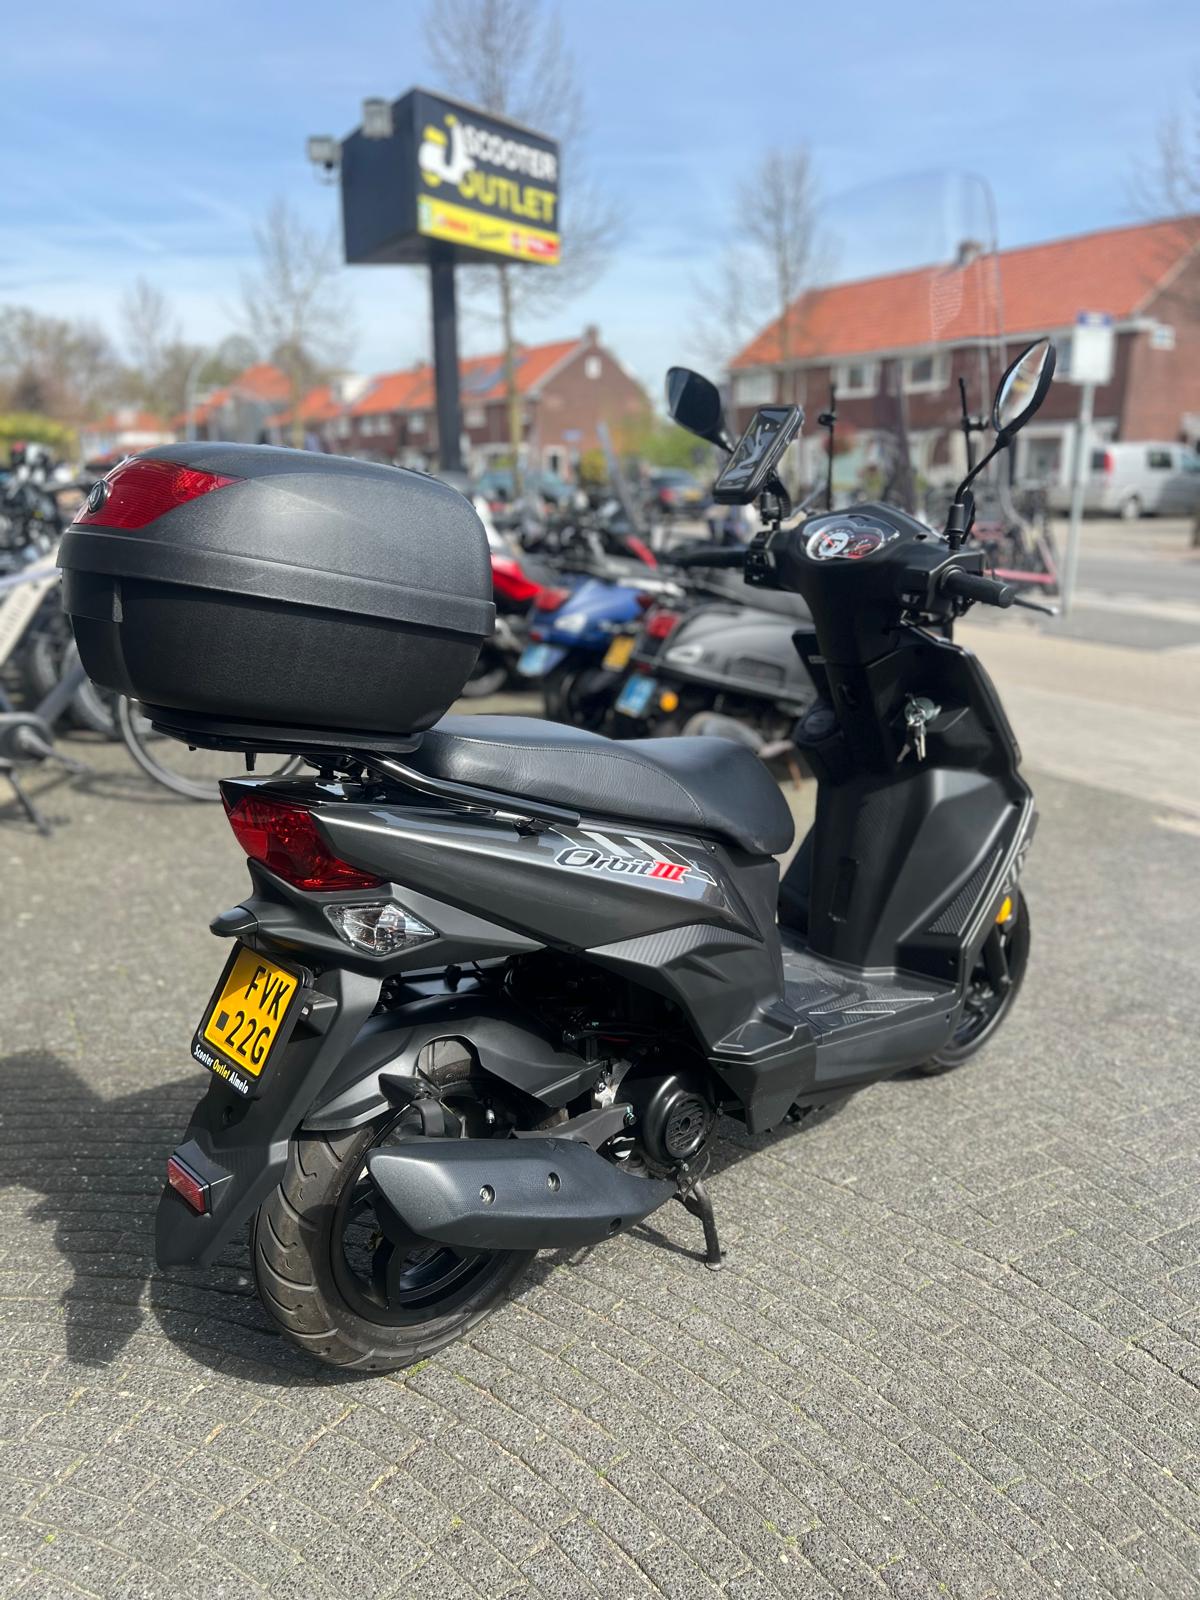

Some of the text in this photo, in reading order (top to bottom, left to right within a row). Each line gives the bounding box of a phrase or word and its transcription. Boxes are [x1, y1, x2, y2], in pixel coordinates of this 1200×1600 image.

[463, 125, 558, 183] SCOOTER
[458, 169, 556, 222] OUTLET
[244, 965, 290, 1020] FVK
[224, 1011, 271, 1065] 22G
[193, 1044, 249, 1095] Scooter Outlet Almelo
